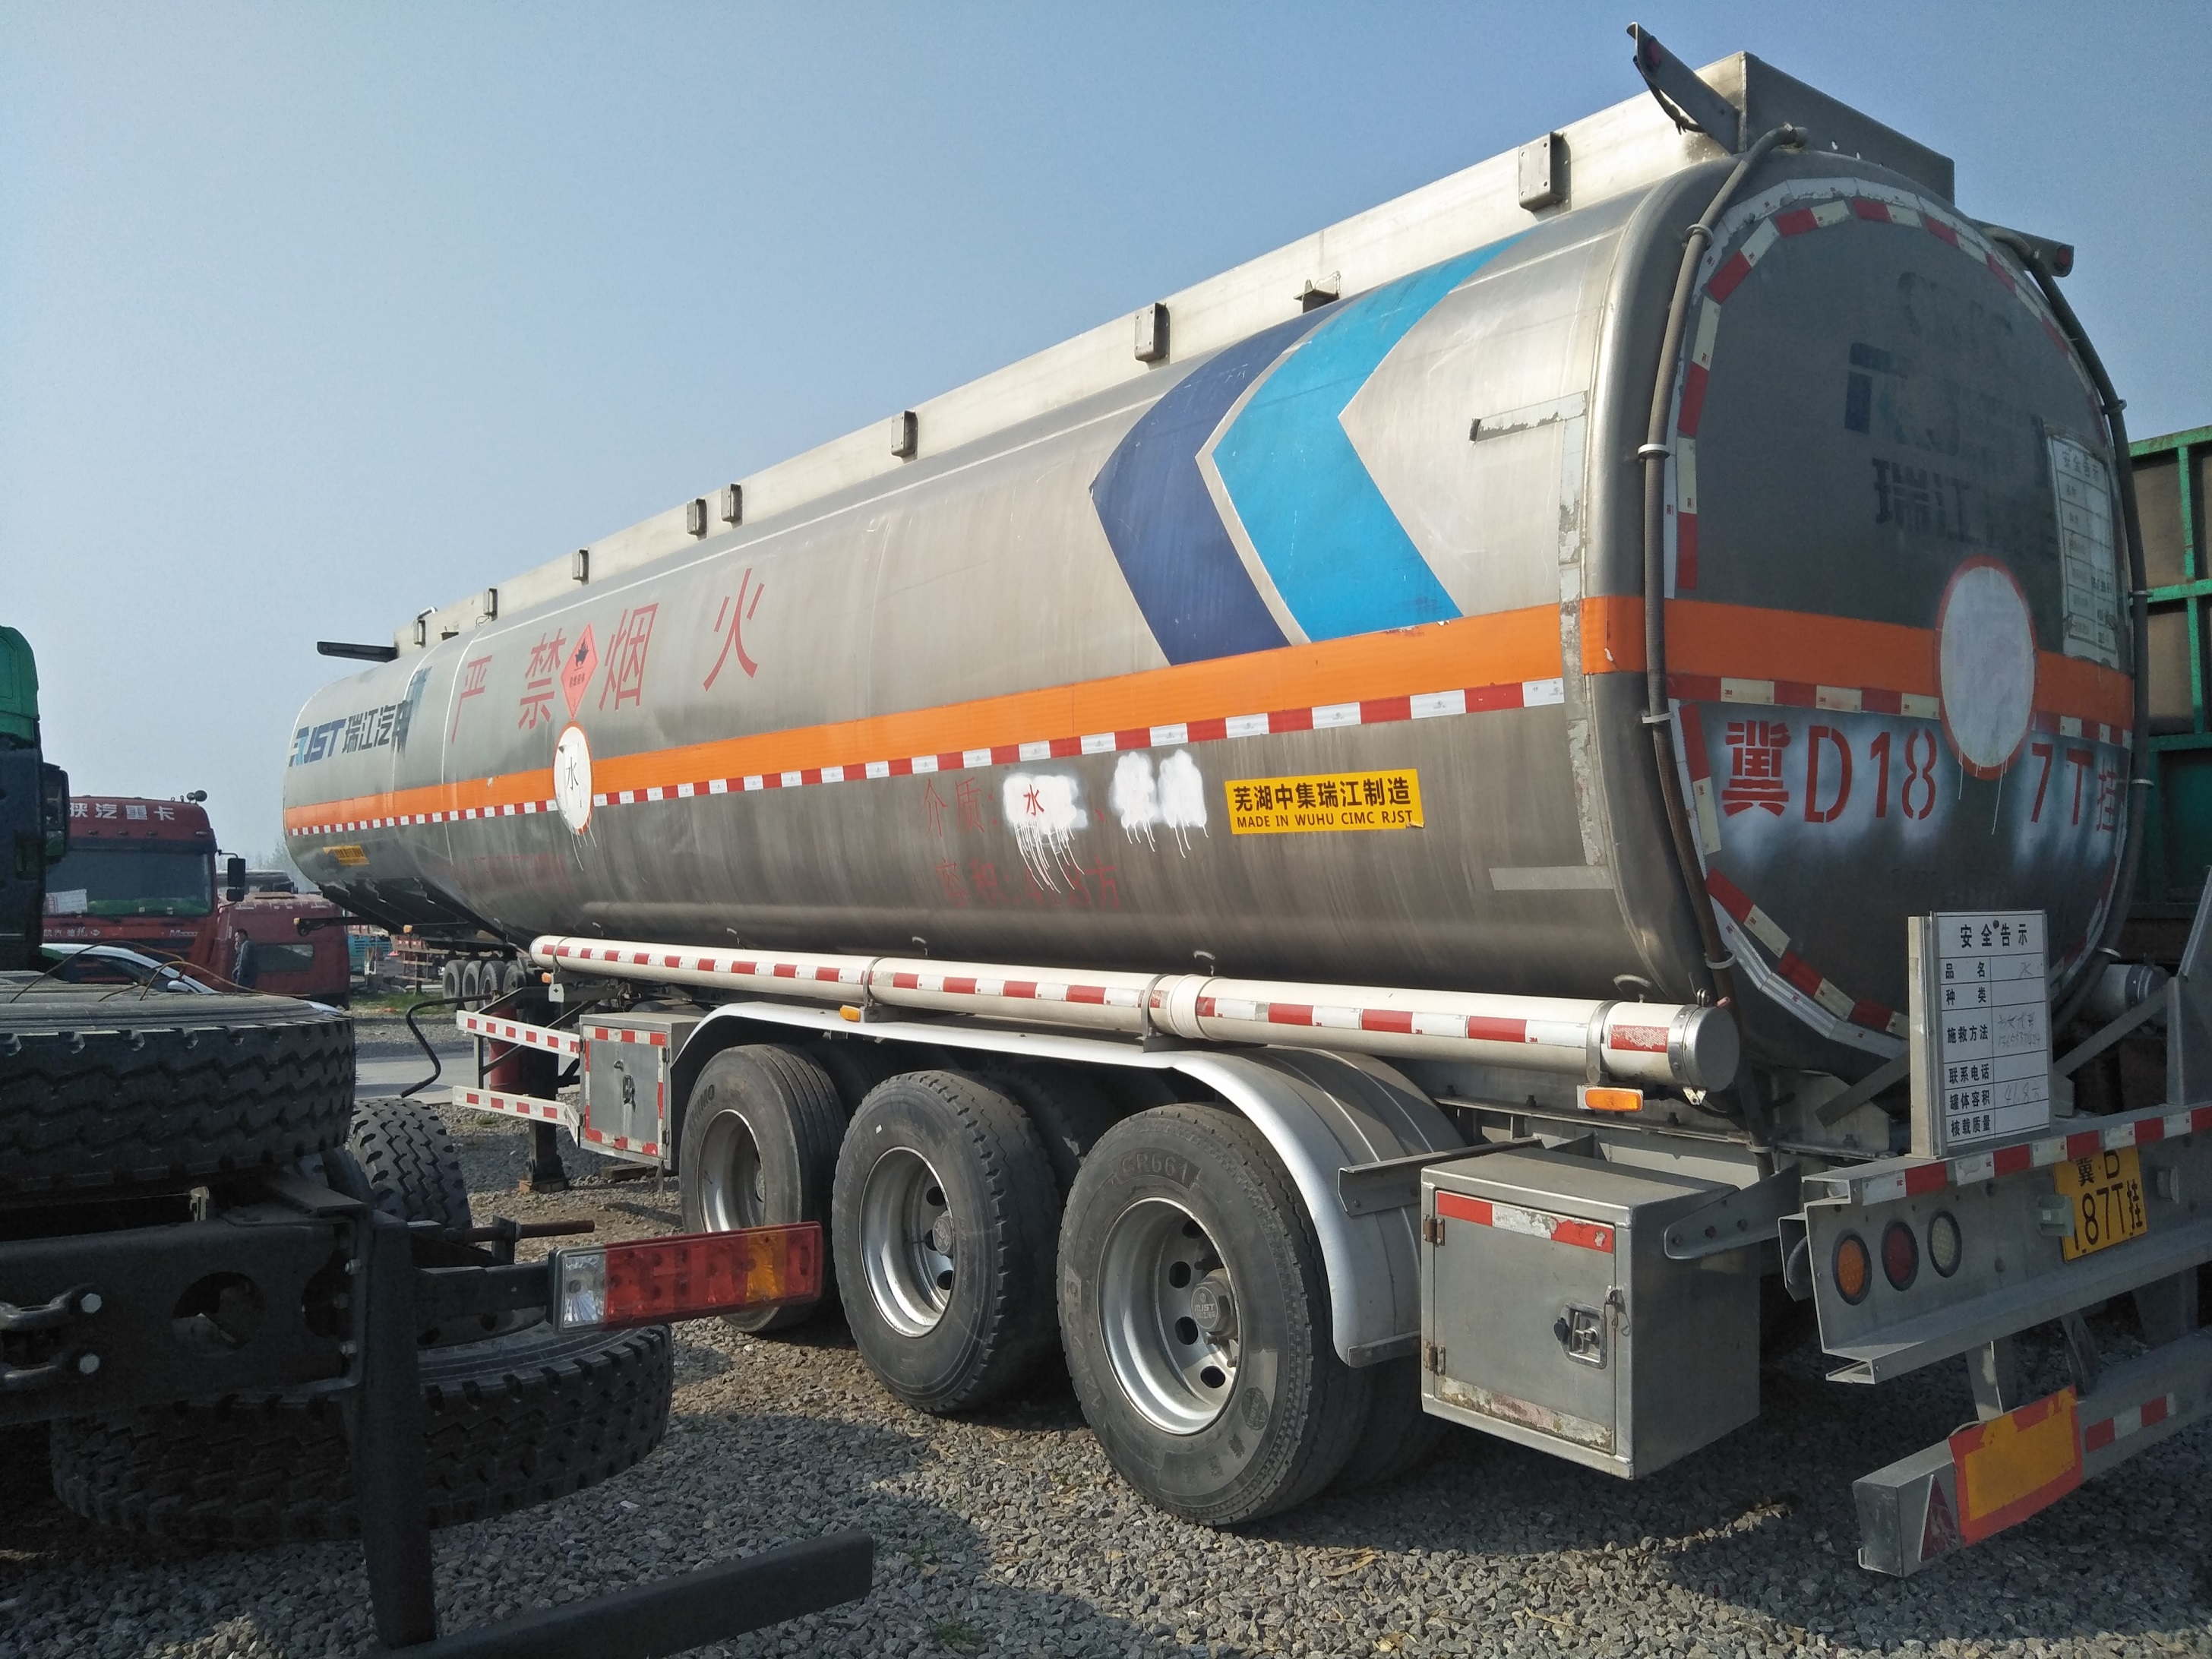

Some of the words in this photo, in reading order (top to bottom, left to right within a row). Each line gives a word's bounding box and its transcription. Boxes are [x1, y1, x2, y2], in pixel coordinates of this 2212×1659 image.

[565, 757, 579, 792] 水
[1023, 784, 1044, 817] 水
[1233, 776, 1411, 812] 芜湖中集瑞江制造
[1237, 815, 1270, 828] MADE
[1275, 814, 1289, 826] IN
[1294, 813, 1335, 826] WUHU
[1341, 811, 1375, 824] CIMC
[1382, 810, 1413, 823] RJST
[1960, 923, 2027, 949] 安全告示
[1945, 961, 1986, 980] 品名
[1945, 986, 1986, 1006] 种类
[1947, 1025, 1989, 1044] 施救方法
[1948, 1063, 1990, 1083] 联系电话
[1949, 1089, 1991, 1111] 罐体容积
[1951, 1114, 1991, 1137] 核载质量
